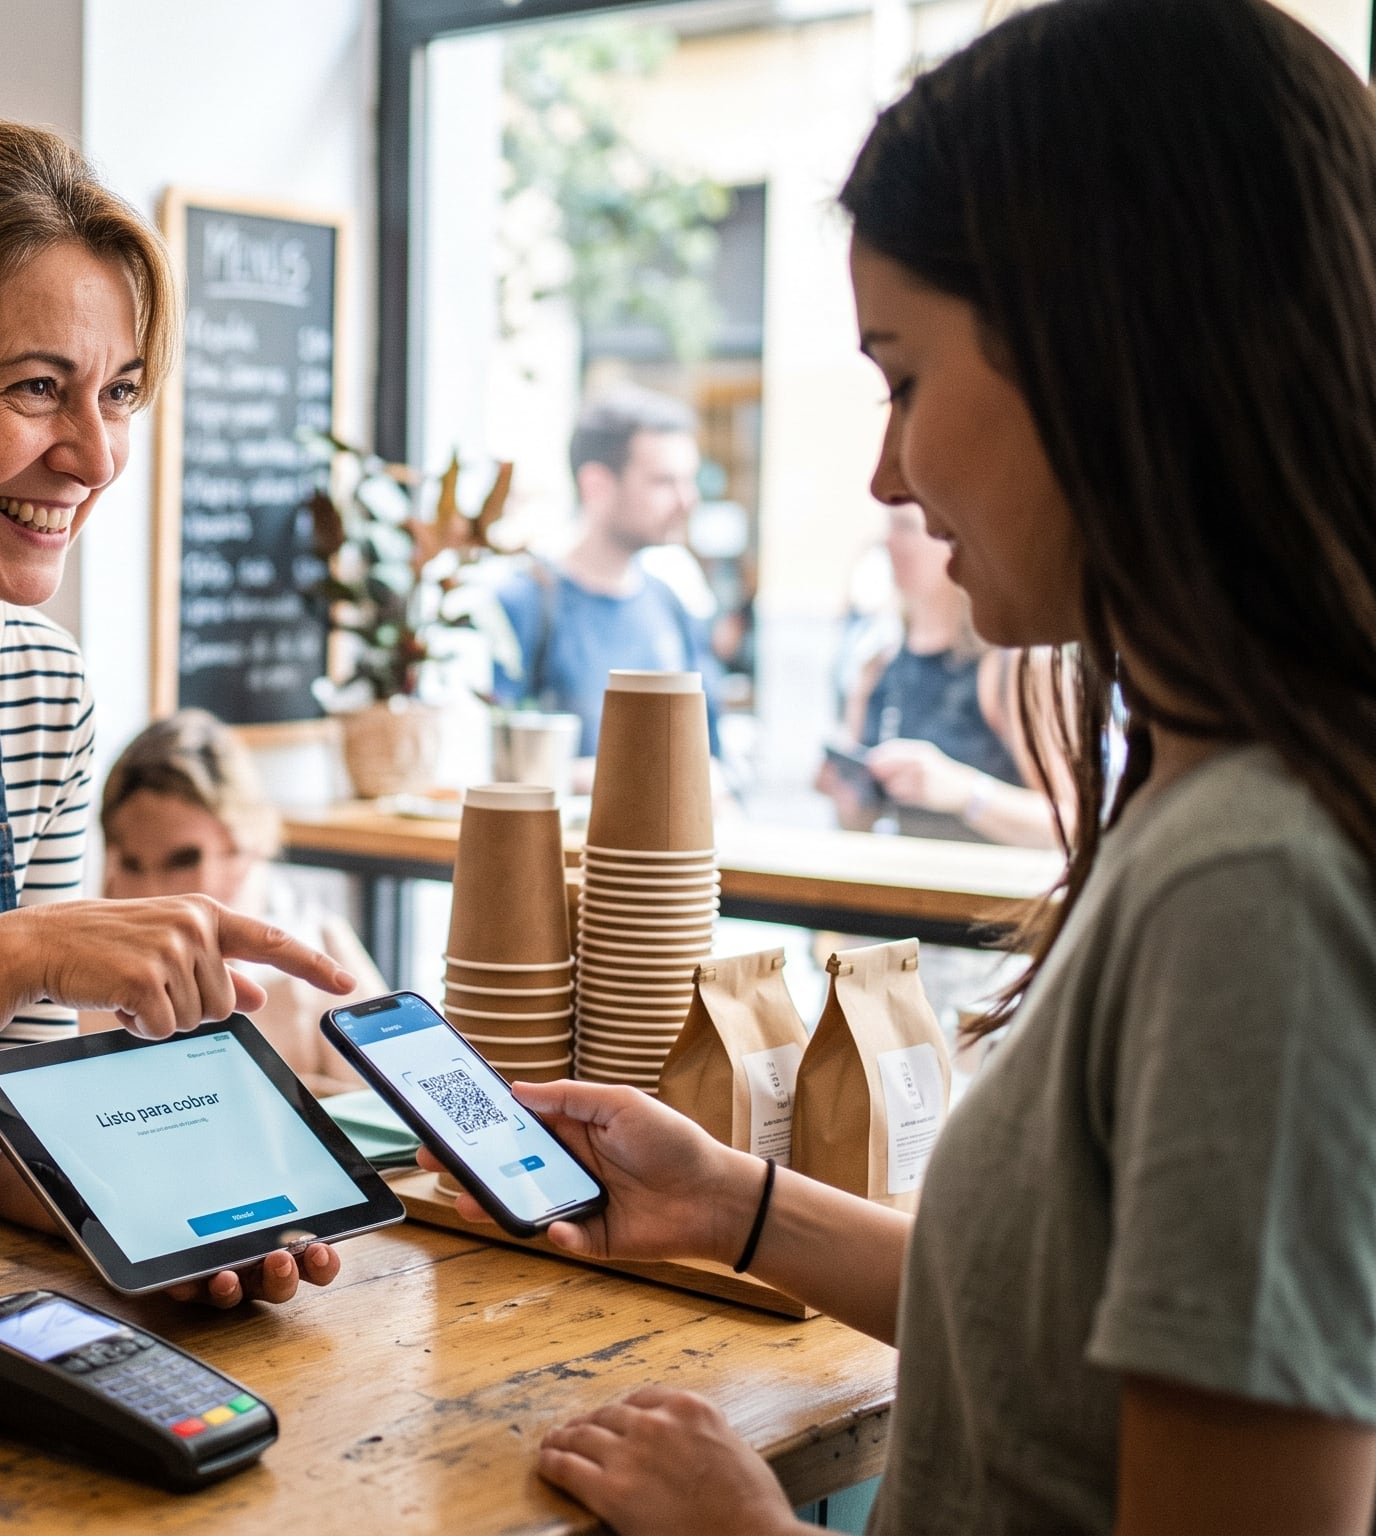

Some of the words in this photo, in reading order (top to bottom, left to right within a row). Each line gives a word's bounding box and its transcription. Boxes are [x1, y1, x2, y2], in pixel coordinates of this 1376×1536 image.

[96, 1110, 136, 1128] Listo
[137, 1103, 173, 1123] para
[173, 1093, 220, 1111] cobrar
